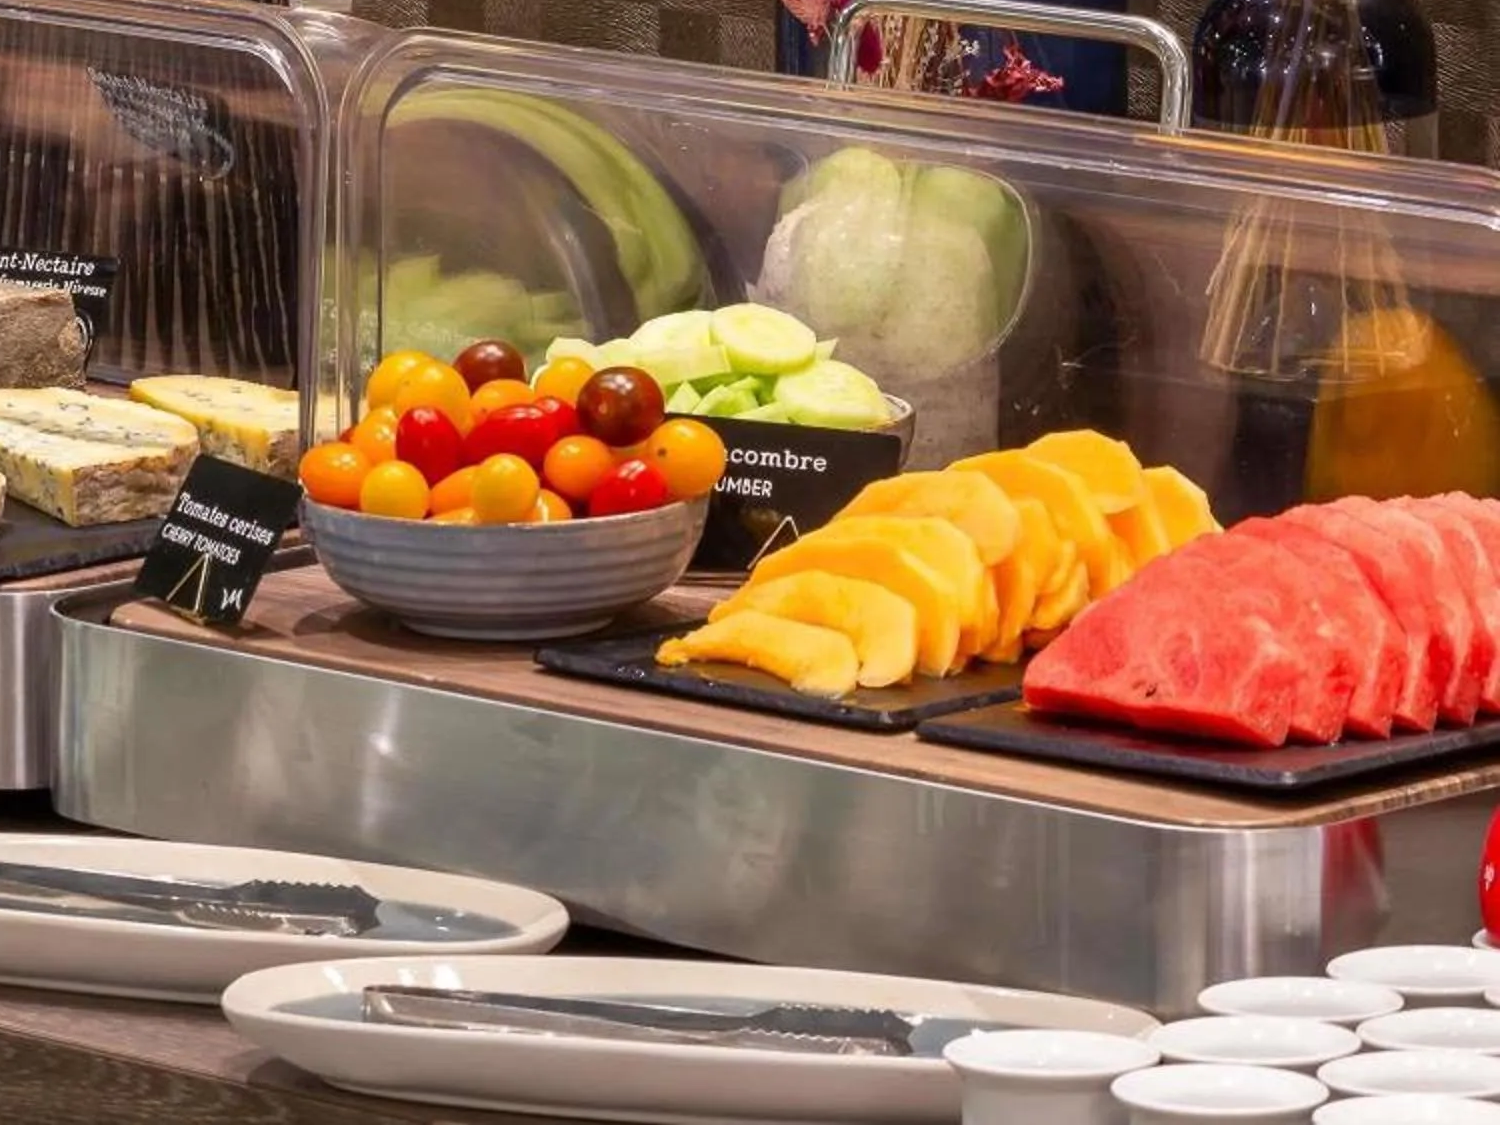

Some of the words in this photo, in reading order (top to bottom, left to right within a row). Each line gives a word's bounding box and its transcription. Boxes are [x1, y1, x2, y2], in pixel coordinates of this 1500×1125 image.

[723, 447, 827, 472] combre
[176, 491, 230, 528] Tomates
[229, 516, 276, 546] cerises
[161, 523, 198, 549] CHERRY
